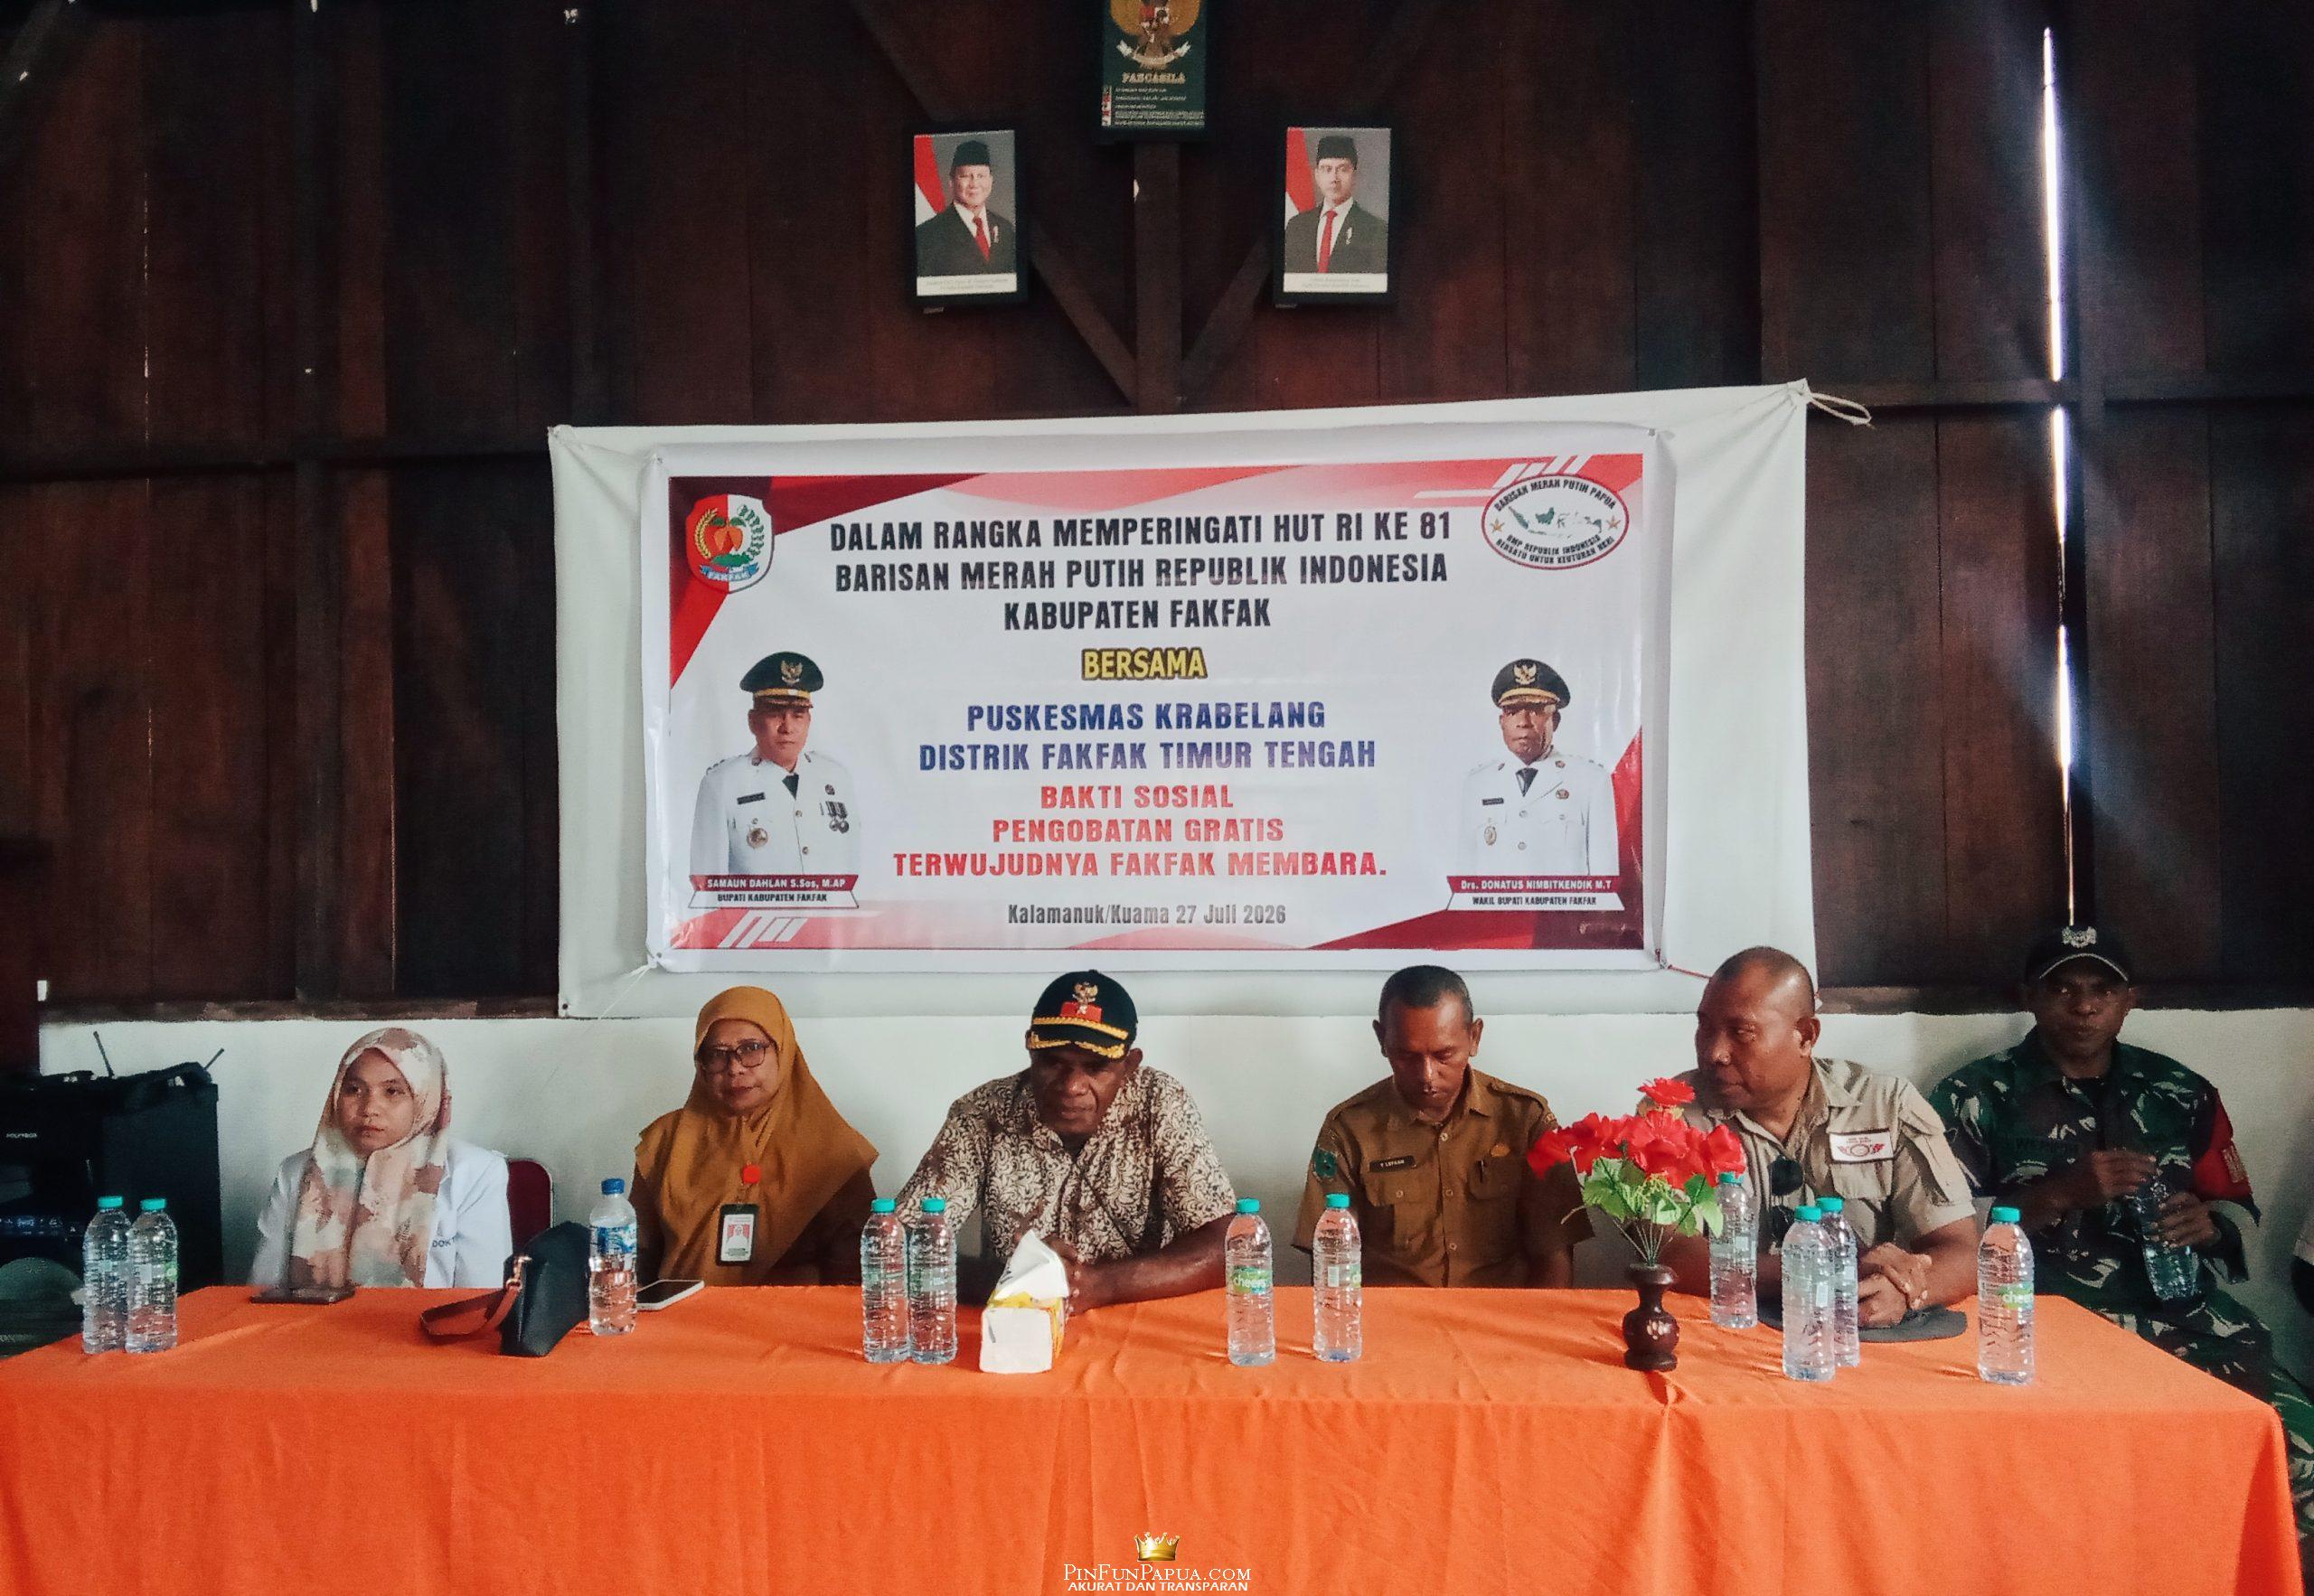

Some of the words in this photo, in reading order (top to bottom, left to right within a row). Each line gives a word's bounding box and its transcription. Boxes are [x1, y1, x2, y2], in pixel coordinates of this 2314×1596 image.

[1493, 486, 1529, 512] BARISAN
[1530, 479, 1560, 492] MERAH
[1563, 479, 1589, 493] PUTIH
[1590, 487, 1617, 510] PAPUA
[830, 521, 923, 551] DALAM
[933, 519, 1041, 549] RANGKA
[1053, 514, 1262, 548] MEMPERINGATI
[1274, 513, 1325, 542] HUT
[1336, 512, 1362, 541] RI
[1374, 511, 1408, 540] KE
[1420, 511, 1451, 540] 81
[1496, 539, 1527, 559] BERSATU
[1529, 554, 1554, 564] UNTUK
[1524, 541, 1559, 555] REPUBLIK
[1562, 534, 1601, 554] INDONESIA
[835, 561, 949, 592] BARISAN
[960, 559, 1055, 590] MERAH
[1067, 559, 1144, 588] PUTIH
[1155, 556, 1287, 587] REPUBLIK
[1300, 552, 1448, 585] INDONESIA
[1004, 599, 1159, 631] KABUPATEN
[1170, 597, 1271, 629] FAKFAK
[1082, 647, 1208, 681] BERSAMA
[967, 703, 1143, 731] PUSKESMAS
[1155, 701, 1325, 730] KRABELANG
[919, 744, 1030, 770] DISTRIK
[1042, 742, 1147, 769] FAKFAK
[1160, 741, 1252, 769] TIMUR
[1265, 740, 1375, 768] TENGAH
[1040, 785, 1122, 809] BAKTI
[1133, 784, 1234, 808] SOSIAL
[992, 819, 1172, 842] PENGOBATAN
[1184, 818, 1284, 842] GRATIS
[893, 853, 1098, 877] TERWUJUDNYA
[1110, 852, 1215, 876] FAKFAK
[1228, 851, 1387, 876] MEMBARA.
[707, 878, 747, 888] SAMAUN
[749, 878, 787, 888] DAHLAN
[790, 878, 819, 889] S.Sos,
[822, 878, 845, 887] M.AP
[1461, 880, 1479, 889] Drs.
[1481, 879, 1524, 889] DONATUS
[1526, 879, 1593, 889] NIMBITKENDIK
[717, 894, 747, 902] BUPATI
[748, 894, 795, 902] KABUPATEN
[796, 894, 827, 902] FAKFAK
[1472, 897, 1494, 905] WAKIL
[1497, 897, 1523, 905] BUPATI
[1525, 897, 1567, 905] KABUPATEN
[1569, 897, 1596, 905] FAKFAK
[1008, 904, 1169, 924] Kalamanuk/Kuama
[1175, 904, 1197, 924] 27
[1203, 904, 1237, 924] Juli
[1243, 904, 1286, 924] 2026
[432, 1237, 456, 1247] DOK
